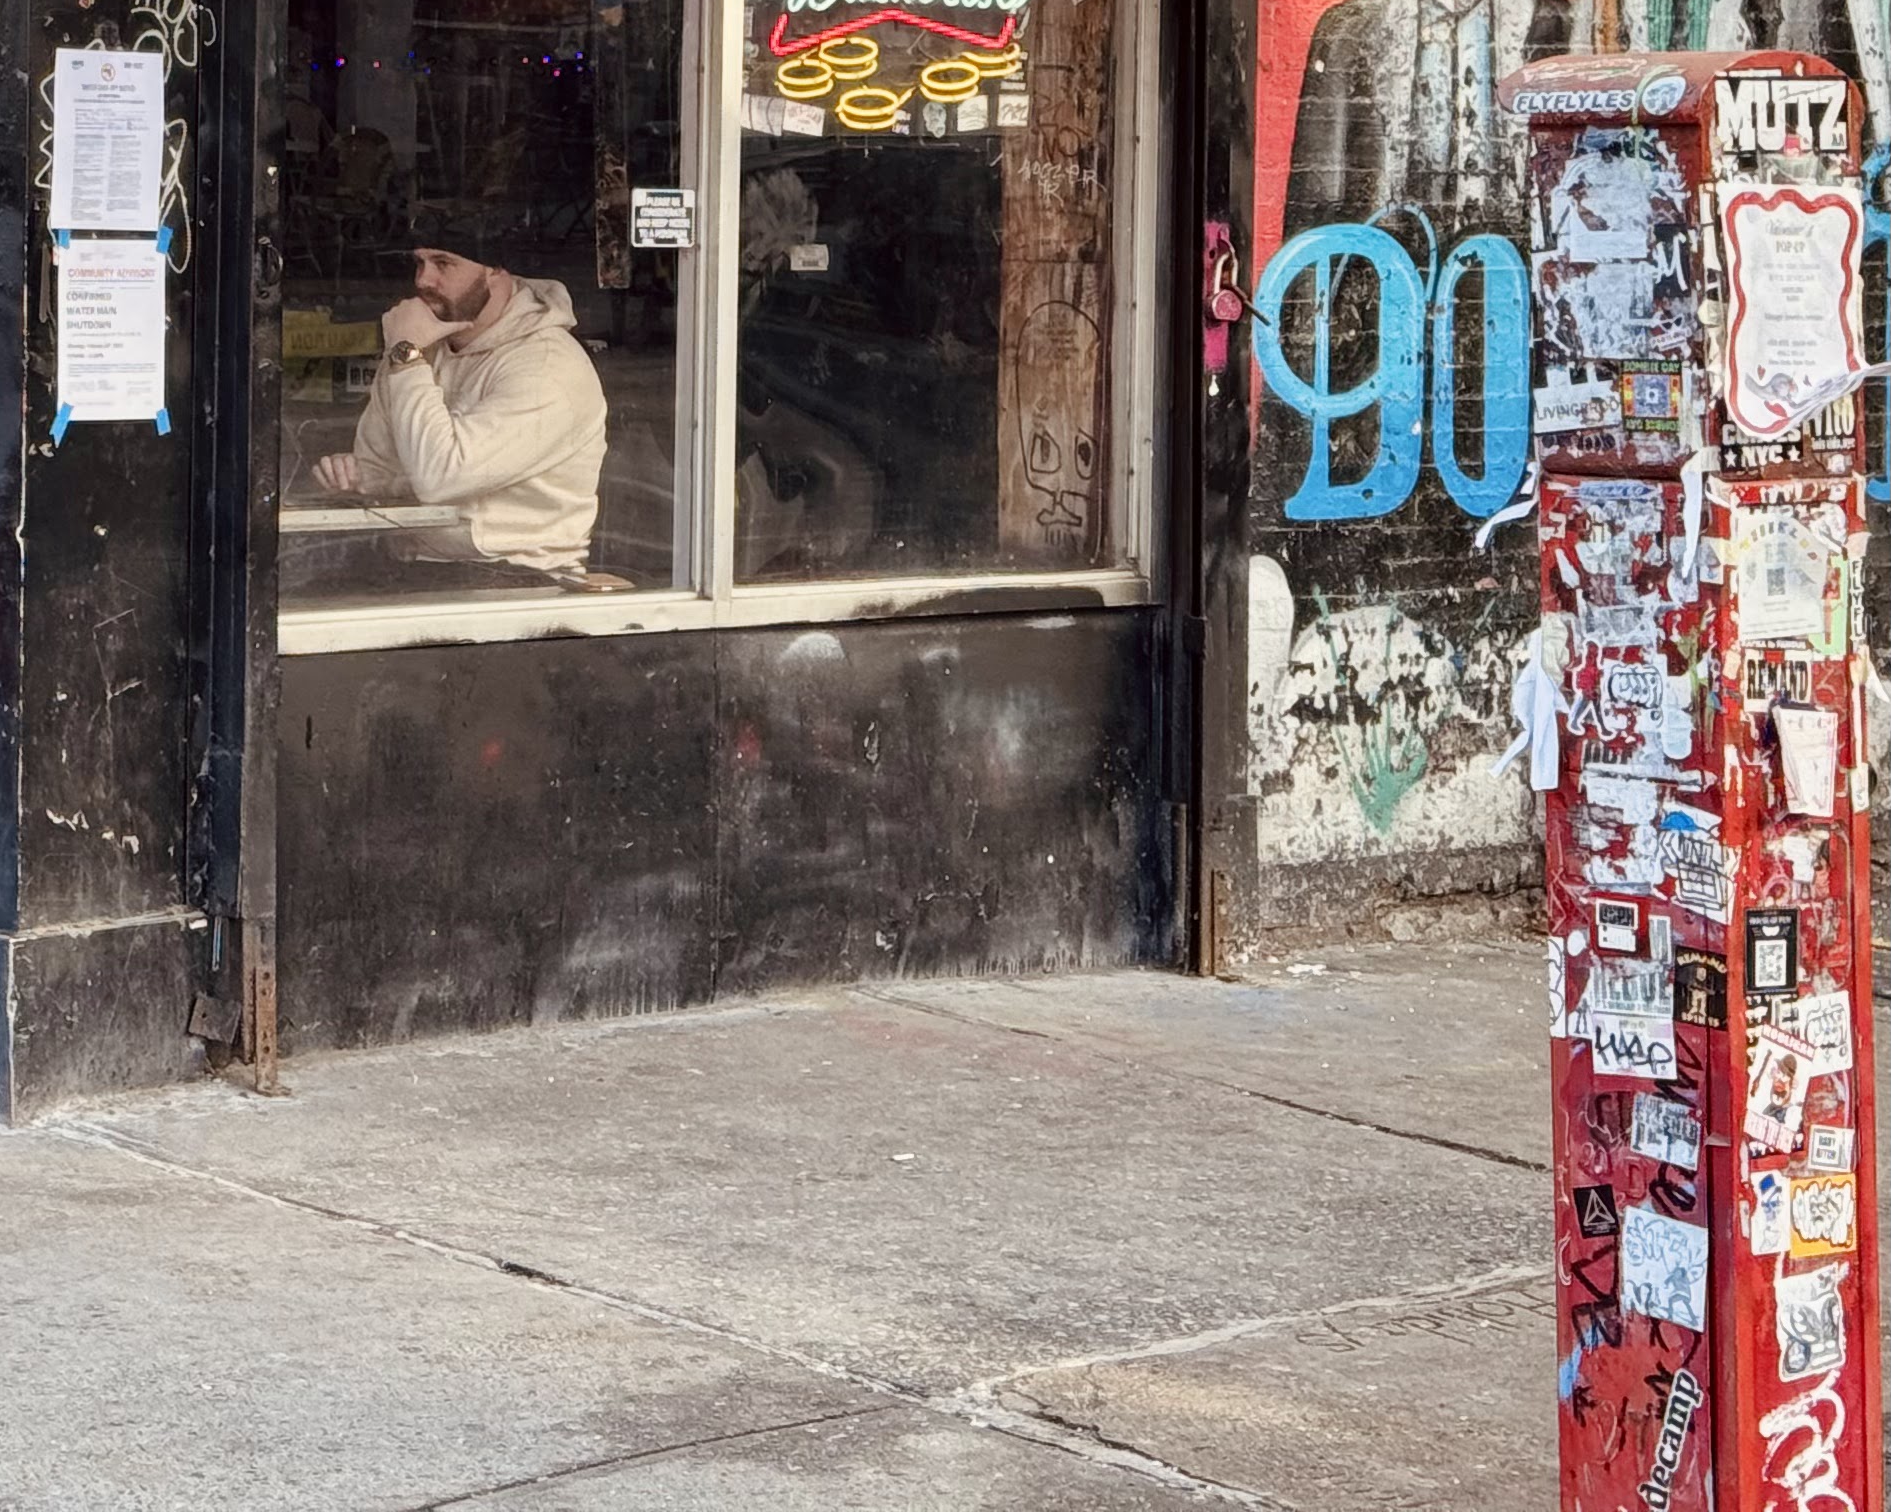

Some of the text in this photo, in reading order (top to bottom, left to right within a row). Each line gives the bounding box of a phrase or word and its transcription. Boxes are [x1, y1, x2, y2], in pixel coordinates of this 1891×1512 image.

[1516, 92, 1633, 111] FLYFLYLES
[1714, 79, 1847, 151] MUTZ
[1740, 444, 1784, 468] NYC
